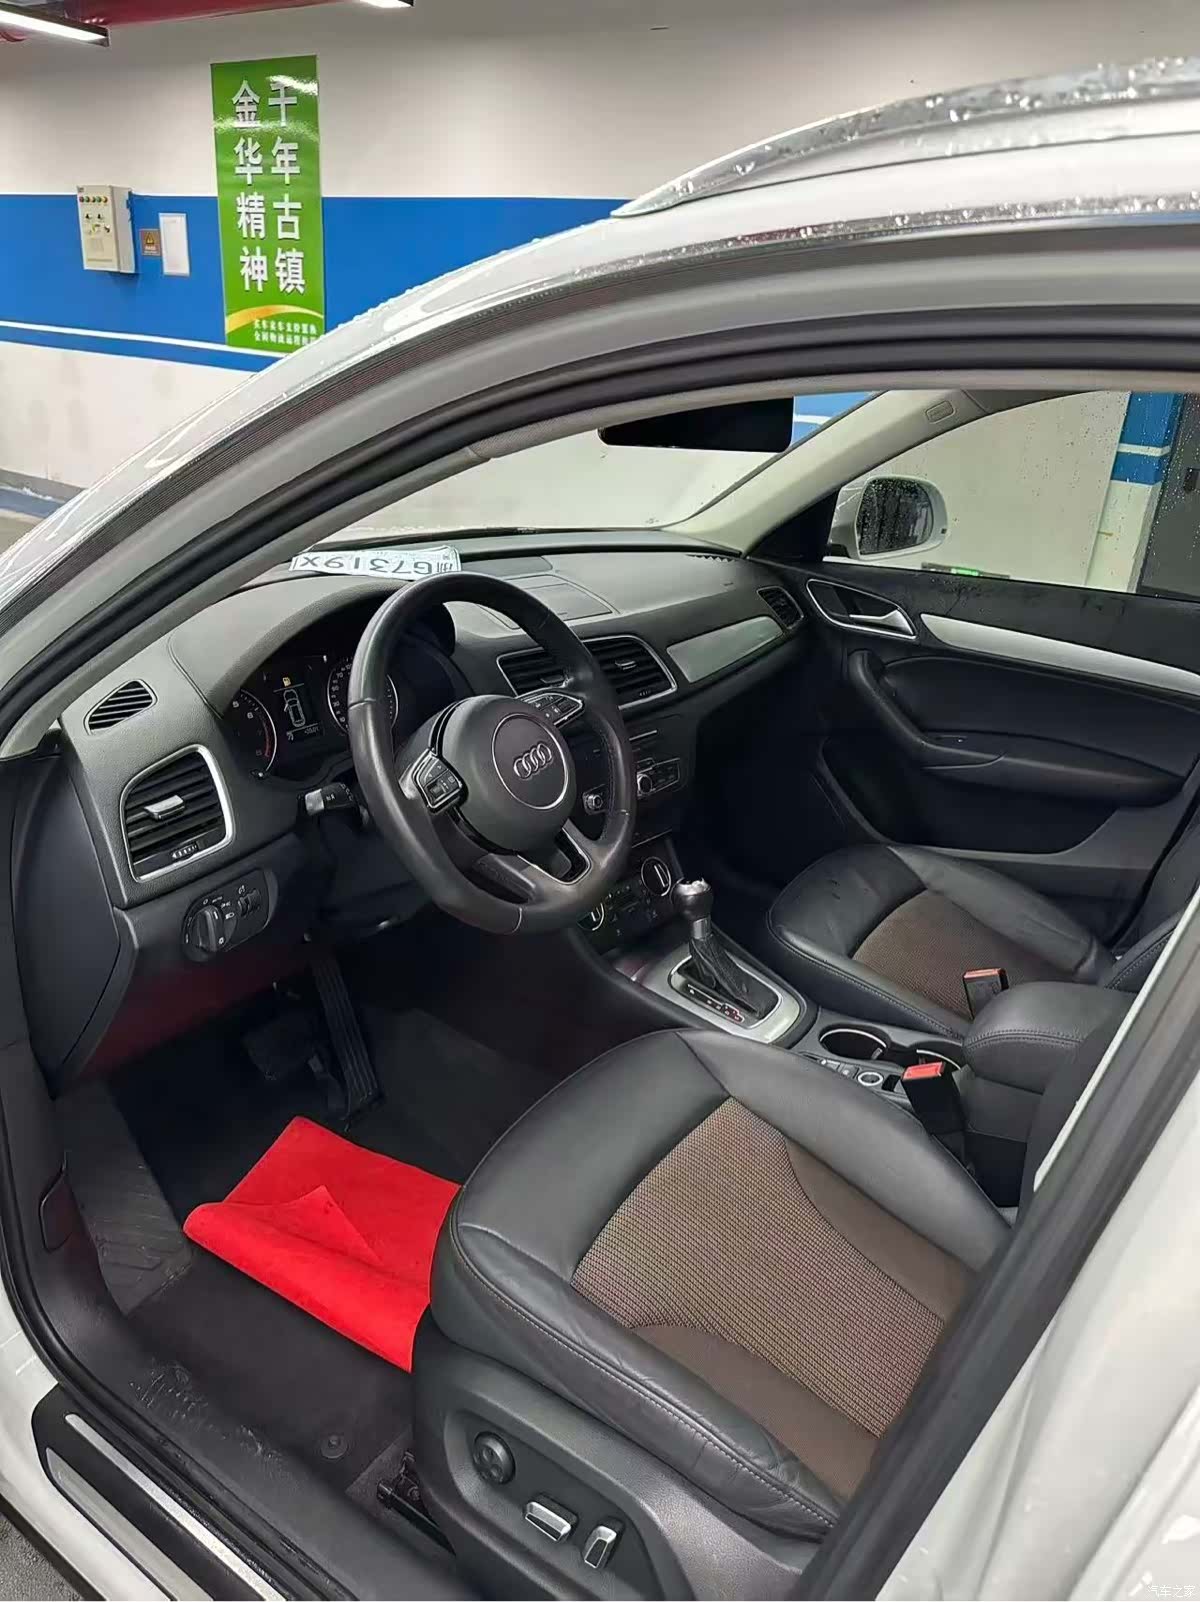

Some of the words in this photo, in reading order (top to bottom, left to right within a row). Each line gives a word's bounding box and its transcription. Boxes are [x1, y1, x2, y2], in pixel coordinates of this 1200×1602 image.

[232, 79, 269, 293] 金华精神
[267, 79, 306, 295] 千年古镇
